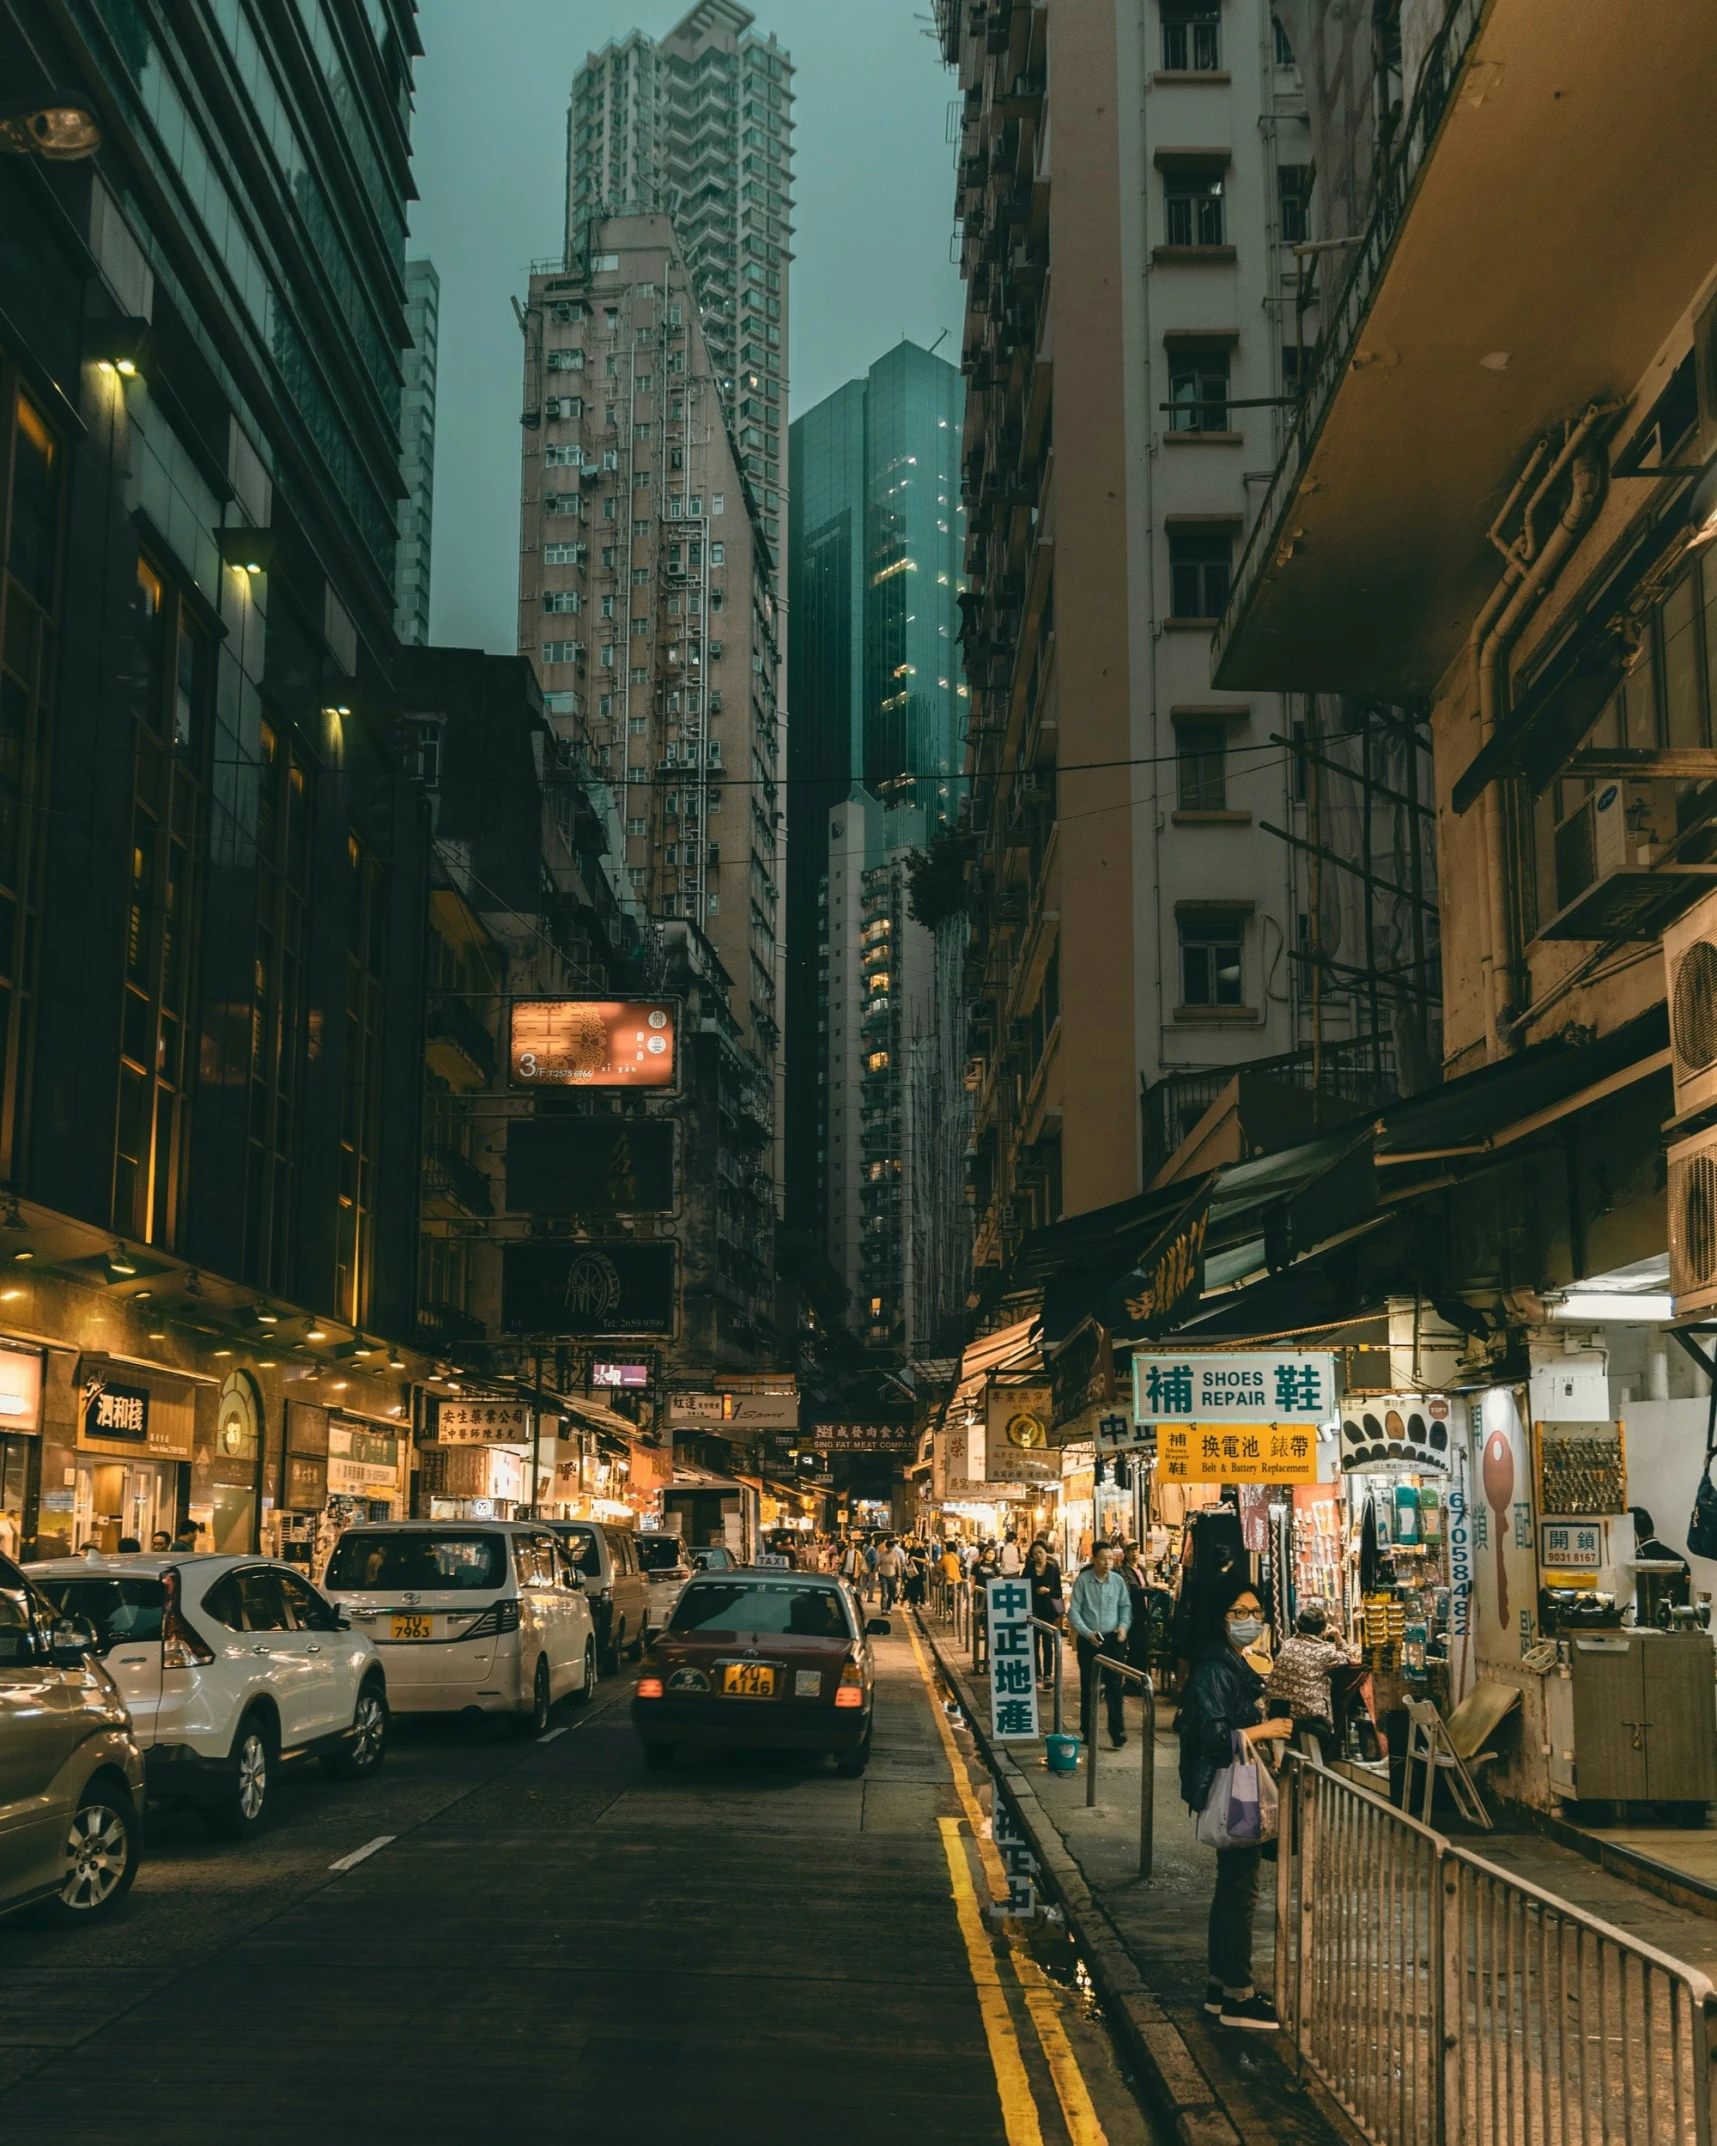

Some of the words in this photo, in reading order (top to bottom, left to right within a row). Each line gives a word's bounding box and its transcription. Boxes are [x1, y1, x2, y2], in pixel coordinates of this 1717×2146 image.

[519, 1053, 546, 1077] 3/F
[602, 1318, 618, 1328] Tel:
[620, 1318, 642, 1328] 2659
[643, 1318, 664, 1328] 9399
[1202, 1371, 1263, 1386] SHOES
[1145, 1365, 1194, 1413] 補
[1273, 1364, 1323, 1412] 鞋
[1202, 1391, 1266, 1406] REPAIR
[442, 1408, 524, 1424] 安生藥業公司
[813, 1441, 833, 1449] SING
[836, 1441, 850, 1449] FAT
[854, 1441, 877, 1449] MEAT
[879, 1441, 917, 1449] COMPAN
[1168, 1433, 1187, 1446] 補
[1269, 1435, 1309, 1459] 錶帶
[1168, 1462, 1188, 1475] 鞋
[1201, 1462, 1217, 1473] Belt
[1220, 1462, 1227, 1473] &
[1231, 1462, 1258, 1475] Battery
[1261, 1462, 1310, 1476] Replacement
[1549, 1530, 1595, 1550] 開鎖
[758, 1556, 786, 1566] TAXI
[1449, 1492, 1471, 1636] 67058482
[1548, 1552, 1571, 1562] 9031
[1573, 1553, 1596, 1562] 8167
[404, 1616, 422, 1628] TU
[395, 1626, 430, 1638] 7963
[992, 1583, 1034, 1734] 中正地產
[728, 1682, 770, 1694] 4146
